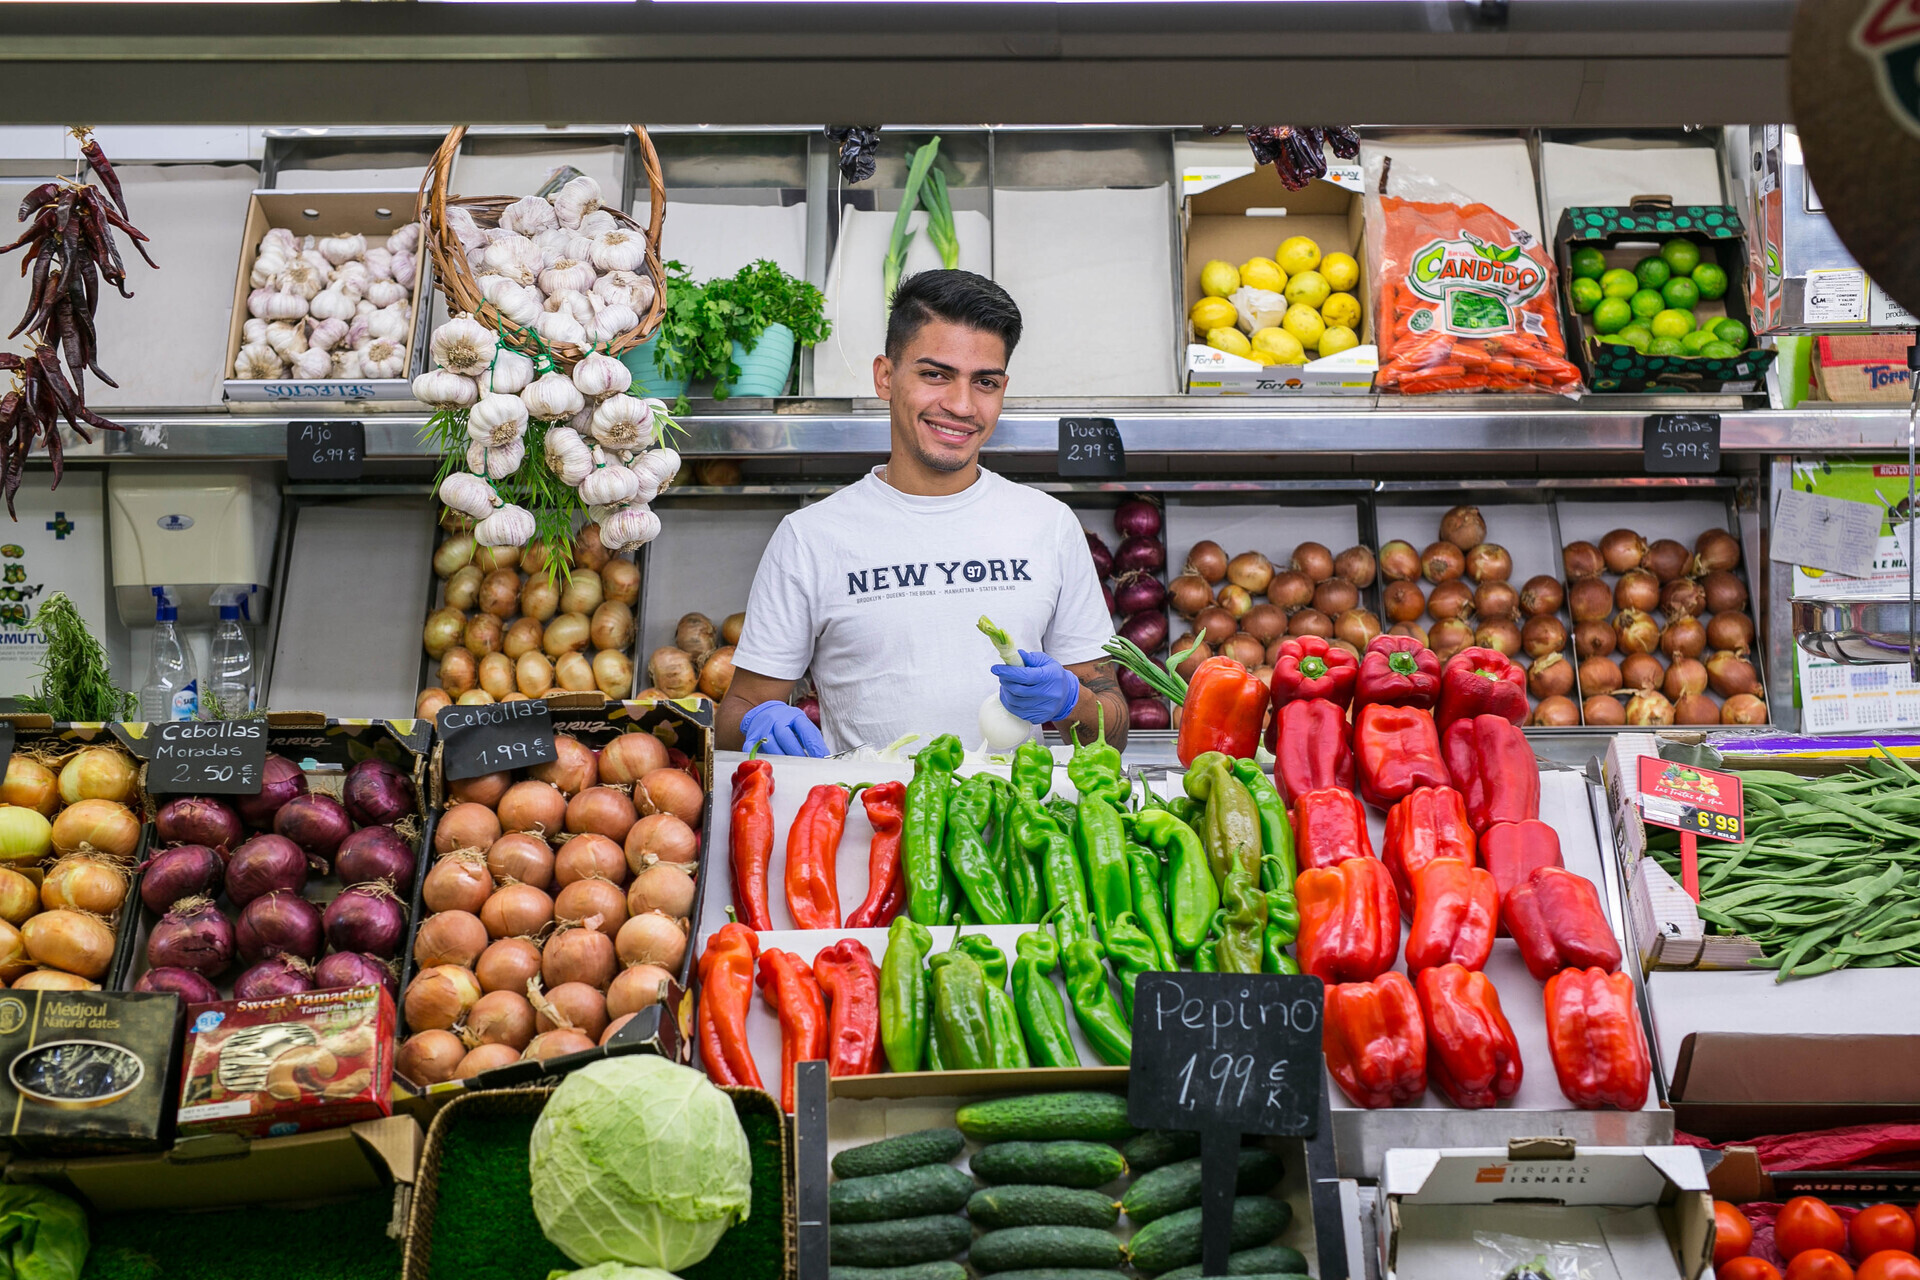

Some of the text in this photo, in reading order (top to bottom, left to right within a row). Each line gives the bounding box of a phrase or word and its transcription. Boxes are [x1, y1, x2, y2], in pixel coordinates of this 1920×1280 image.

[264, 385, 376, 397] SELECTOS
[1658, 416, 1713, 433] Limas
[301, 425, 332, 445] Ajo
[312, 448, 343, 464] 6.99
[1067, 444, 1102, 461] 2.99
[1661, 442, 1698, 459] 5.99
[848, 563, 929, 595] NEW
[856, 594, 882, 604] BROOKLYN
[886, 592, 906, 600] QUEENS
[944, 587, 975, 595] MANHATTAN
[0, 633, 56, 645] MUTU
[442, 700, 549, 729] Cebollas
[162, 721, 261, 741] Cebollas
[155, 743, 243, 760] Moradas
[171, 763, 234, 783] 2.50
[1654, 785, 1668, 793] Las
[1669, 788, 1694, 800] Frutas
[1695, 795, 1706, 803] de
[1697, 811, 1739, 833] 6'99
[236, 985, 377, 1013] Sweet Tamarind
[45, 1001, 108, 1019] Medjoul
[299, 1003, 346, 1015] Tamarin
[1144, 979, 1318, 1050] Pepino
[43, 1017, 121, 1029] Natural dates
[1178, 1053, 1256, 1111] 1,99
[1511, 1166, 1591, 1174] FRUTAS
[1510, 1176, 1588, 1184] ISMAEL
